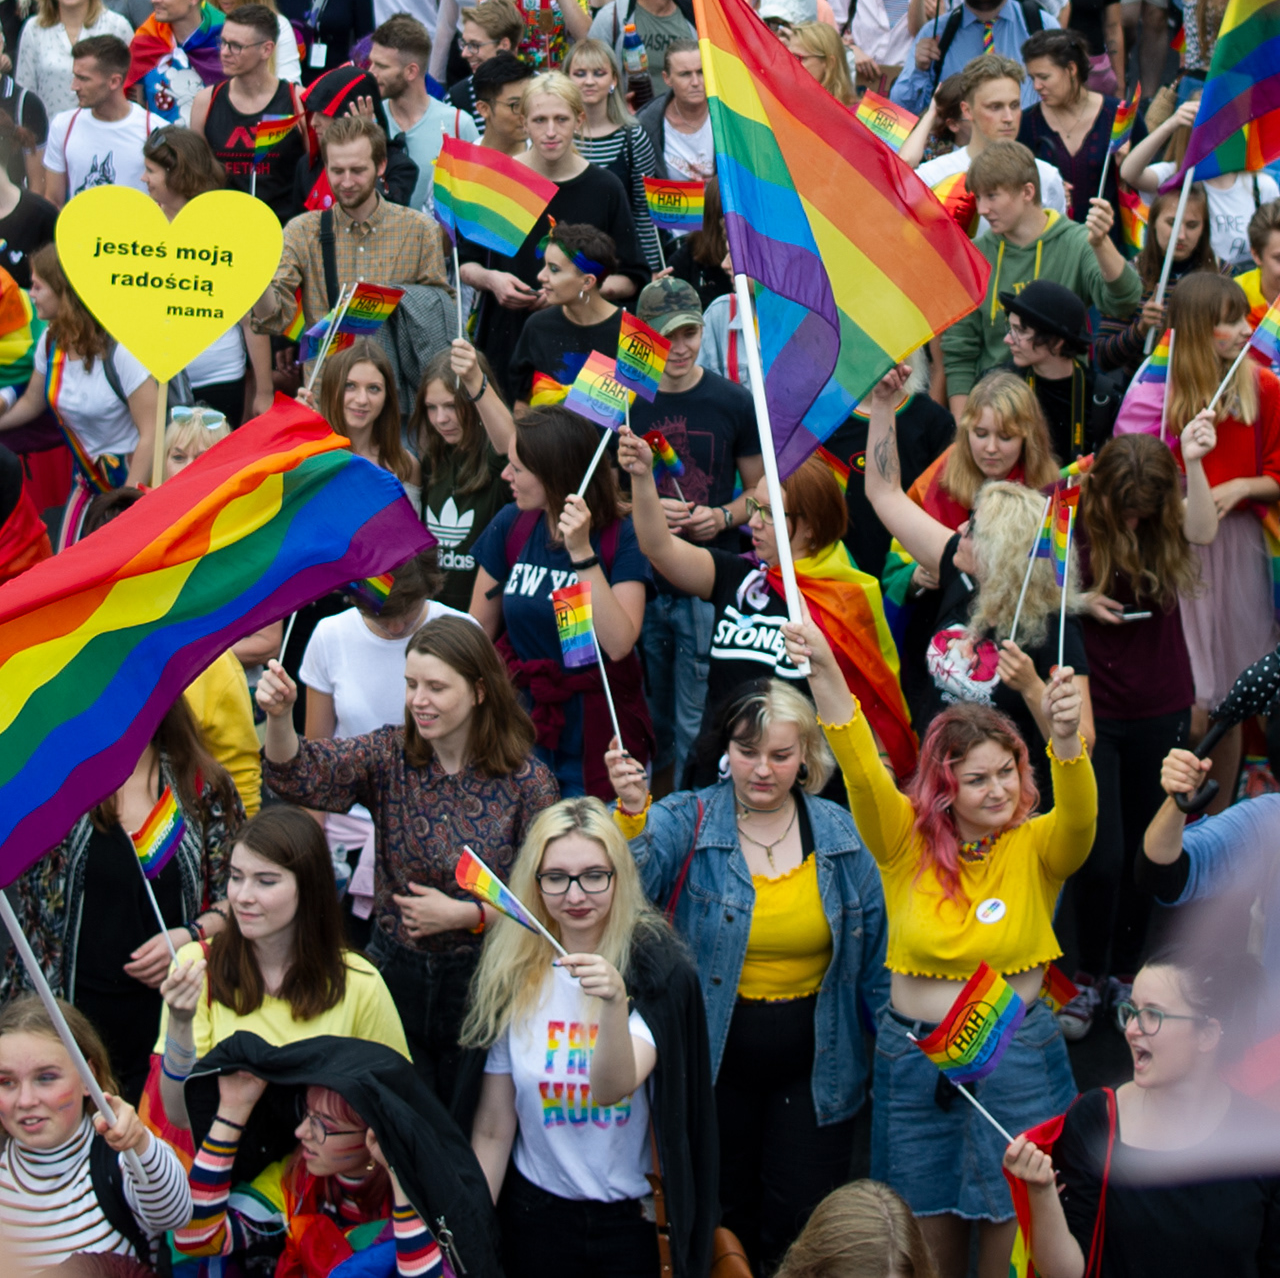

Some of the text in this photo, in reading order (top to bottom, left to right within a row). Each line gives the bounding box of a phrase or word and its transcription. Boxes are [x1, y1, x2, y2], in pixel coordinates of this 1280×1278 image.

[93, 237, 233, 267] jesteś moją
[111, 271, 214, 296] radością
[166, 304, 225, 319] mama
[627, 338, 652, 363] HAH
[438, 549, 475, 570] idas
[504, 563, 579, 601] EW YO
[953, 1009, 985, 1053] HAH
